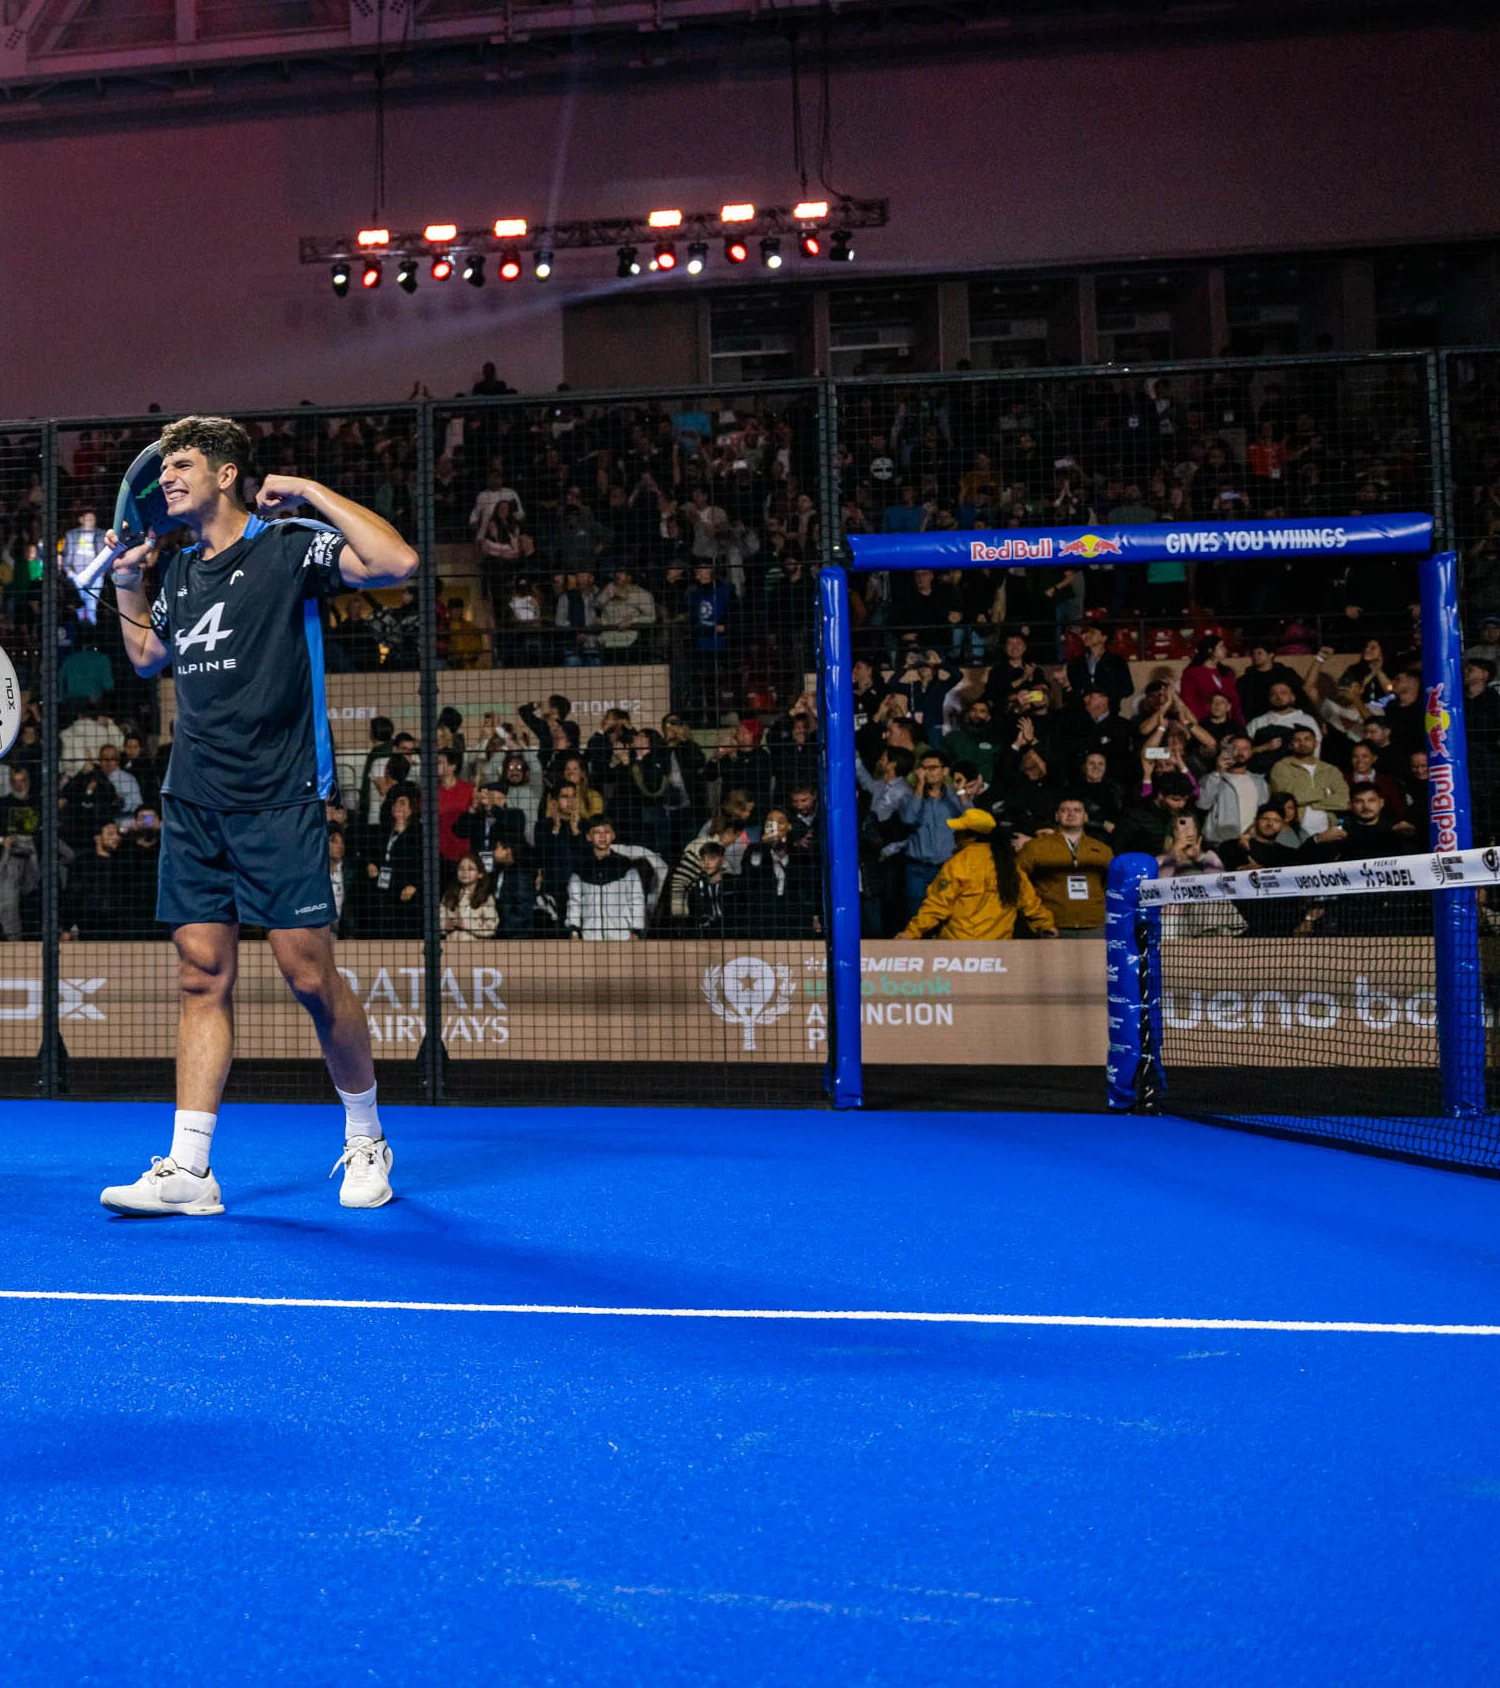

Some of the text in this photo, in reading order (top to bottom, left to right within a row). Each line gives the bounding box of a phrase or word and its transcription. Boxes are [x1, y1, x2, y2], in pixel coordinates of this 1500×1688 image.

[971, 538, 1053, 562] Red Bull
[1165, 532, 1220, 554] GIVES
[1223, 530, 1263, 552] YOU
[1429, 764, 1455, 813] Bull
[1319, 867, 1351, 887] bank
[1377, 869, 1417, 887] PADEL
[1181, 884, 1211, 899] PADEL
[294, 902, 328, 915] HEAD
[822, 957, 1008, 973] EMIER PADEL
[881, 973, 951, 997] bank
[806, 1003, 954, 1026] ANCION
[1164, 991, 1342, 1030] ueno
